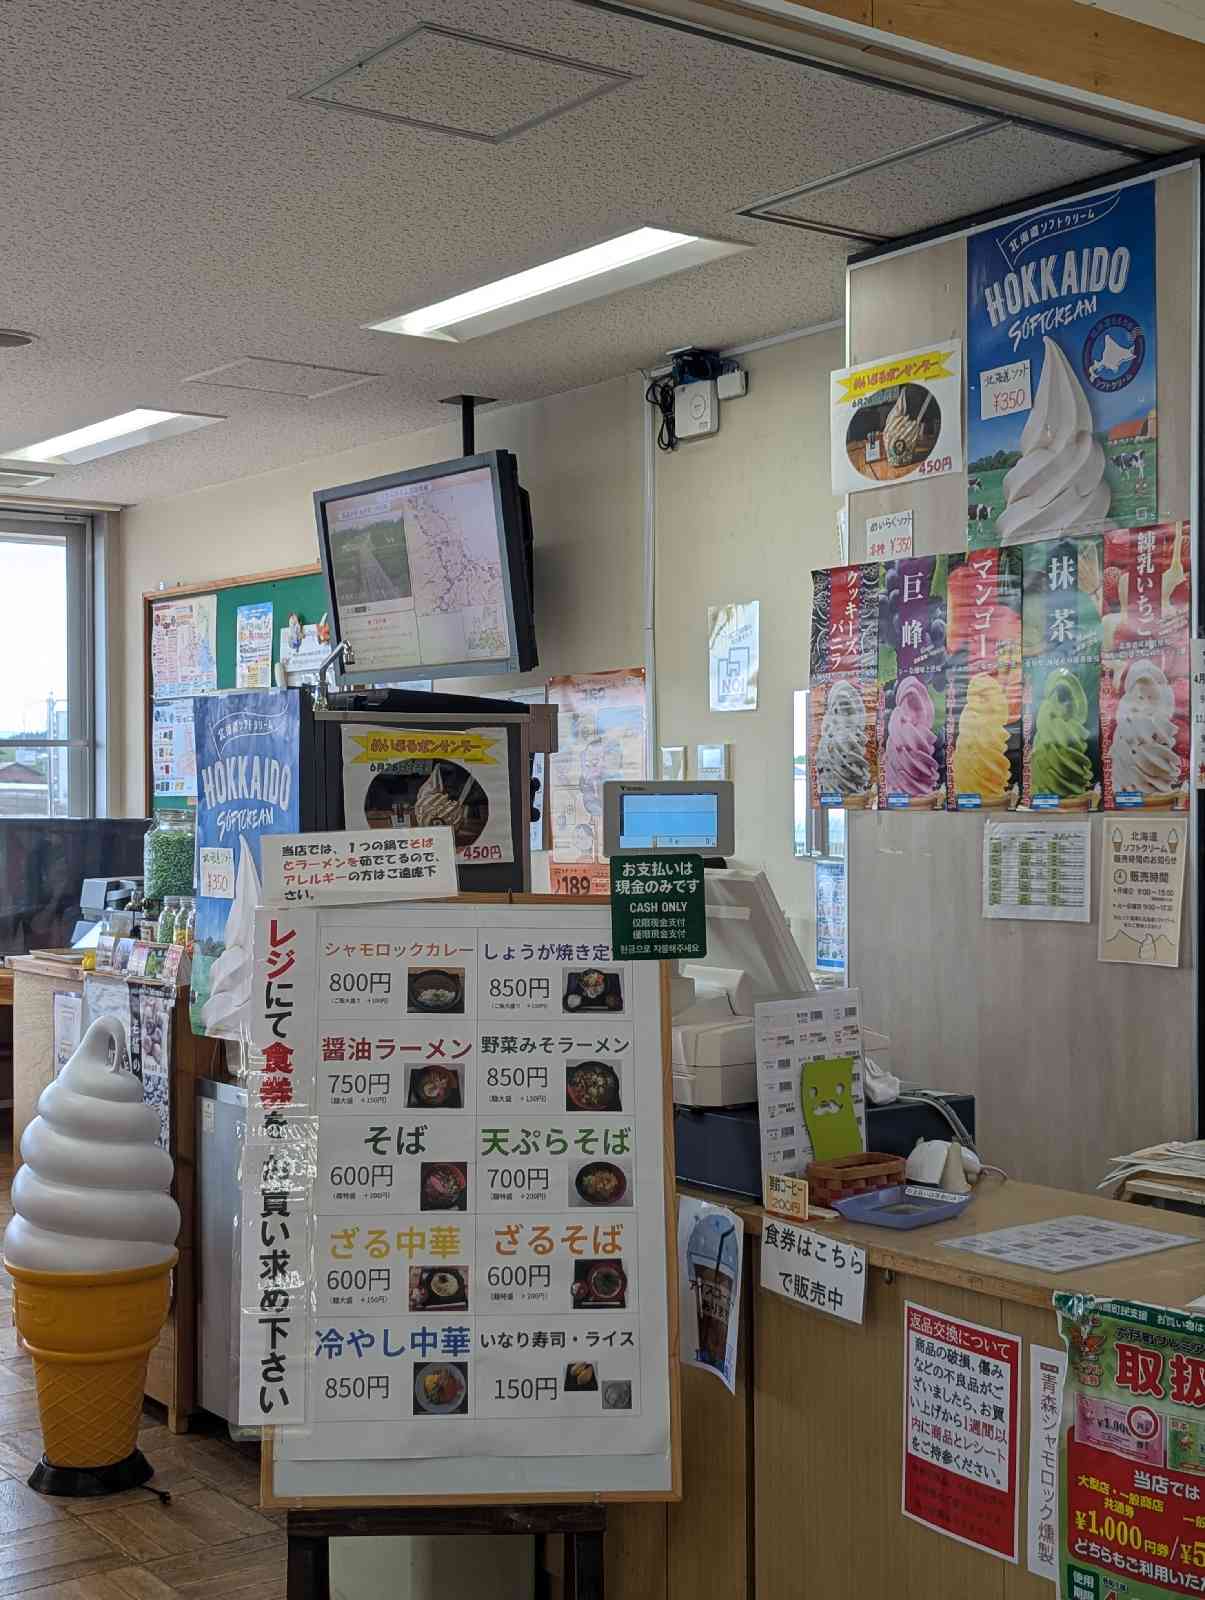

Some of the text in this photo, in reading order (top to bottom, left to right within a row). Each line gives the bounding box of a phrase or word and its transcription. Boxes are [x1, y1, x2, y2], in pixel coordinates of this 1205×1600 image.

[1008, 208, 1096, 254] 北海道ソフトクリーム
[984, 246, 1131, 328] HOKKAIDO
[1008, 296, 1098, 353] SOFTCREAM
[993, 388, 1026, 412] ¥350
[918, 455, 953, 475] 450円
[1136, 530, 1157, 637] 練乳いちご
[902, 572, 925, 649] 巨峰
[972, 558, 994, 657] マンゴー
[1048, 555, 1077, 644] 抹茶
[844, 568, 859, 656] クッキーズ
[829, 619, 844, 671] バニラ
[202, 755, 292, 811] HOKKAIDO
[216, 807, 275, 842] SOFTCREAM
[1130, 831, 1158, 842] 北海道
[463, 845, 503, 860] 450円
[1123, 843, 1168, 854] ソフトクリーム
[283, 852, 440, 871] とラーメンを茹でてるので、
[622, 861, 694, 877] お支払いは
[283, 865, 438, 886] アレルギーの方はご遠慮下
[562, 875, 591, 896] 189
[615, 878, 700, 896] 現金のみです
[1129, 870, 1169, 883] 販売時間
[284, 889, 315, 901] さい。
[629, 901, 688, 913] CASH ONLY
[325, 942, 474, 958] シャモロックカレー
[485, 943, 612, 961] しょうが焼き定
[329, 972, 392, 994] 800円
[489, 978, 550, 999] 850円
[321, 1036, 473, 1062] 醤油ラーメン
[481, 1035, 630, 1054] 野菜みそラーメン
[327, 1073, 391, 1096] 750円
[487, 1066, 548, 1089] 850円
[364, 1124, 428, 1156] そば
[480, 1126, 632, 1157] 天ぷらそば
[330, 1164, 393, 1187] 600円
[487, 1168, 549, 1190] 700円
[330, 1224, 461, 1260] ざる中華
[495, 1223, 624, 1256] ざるそば
[764, 1223, 864, 1275] 食券はこちら
[327, 1268, 391, 1292] 600円
[487, 1264, 551, 1288] 600円
[779, 1270, 844, 1312] で販売中
[314, 1326, 471, 1359] 冷やし中華
[480, 1330, 635, 1348] いなり寿司・ライス
[910, 1311, 1011, 1359] 返品交換について
[914, 1336, 1005, 1379] 商品の破損、傷み
[324, 1375, 390, 1400] 850円
[494, 1377, 558, 1400] 150円
[914, 1356, 1004, 1401] などの不良品がご
[912, 1375, 1005, 1424] ざいましたら、お買
[911, 1415, 1006, 1465] 内に商品とレシート
[911, 1435, 1001, 1486] をご持参ください。
[1133, 1469, 1201, 1501] 当店では
[1103, 1496, 1136, 1519] 共通券
